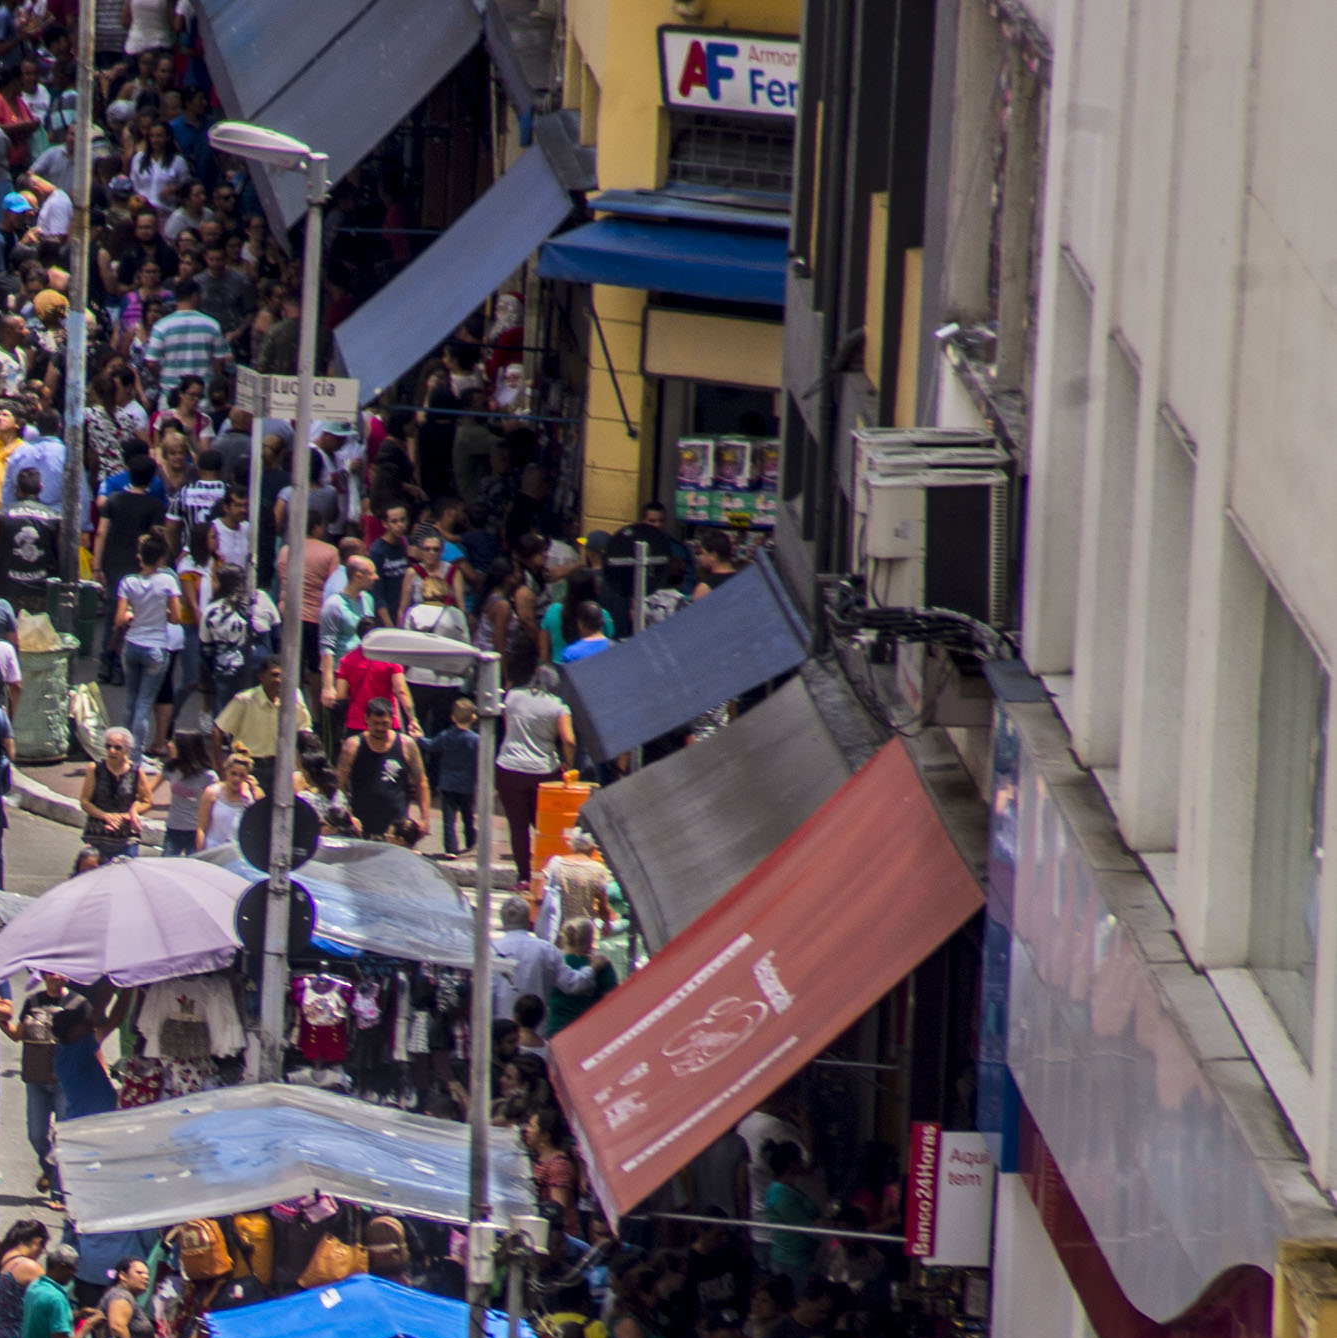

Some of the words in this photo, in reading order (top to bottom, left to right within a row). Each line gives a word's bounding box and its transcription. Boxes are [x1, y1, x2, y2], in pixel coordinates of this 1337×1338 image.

[679, 40, 740, 101] AF
[272, 378, 336, 397] Luccia
[912, 1124, 937, 1257] Banco24Horas
[949, 1171, 982, 1188] tem
